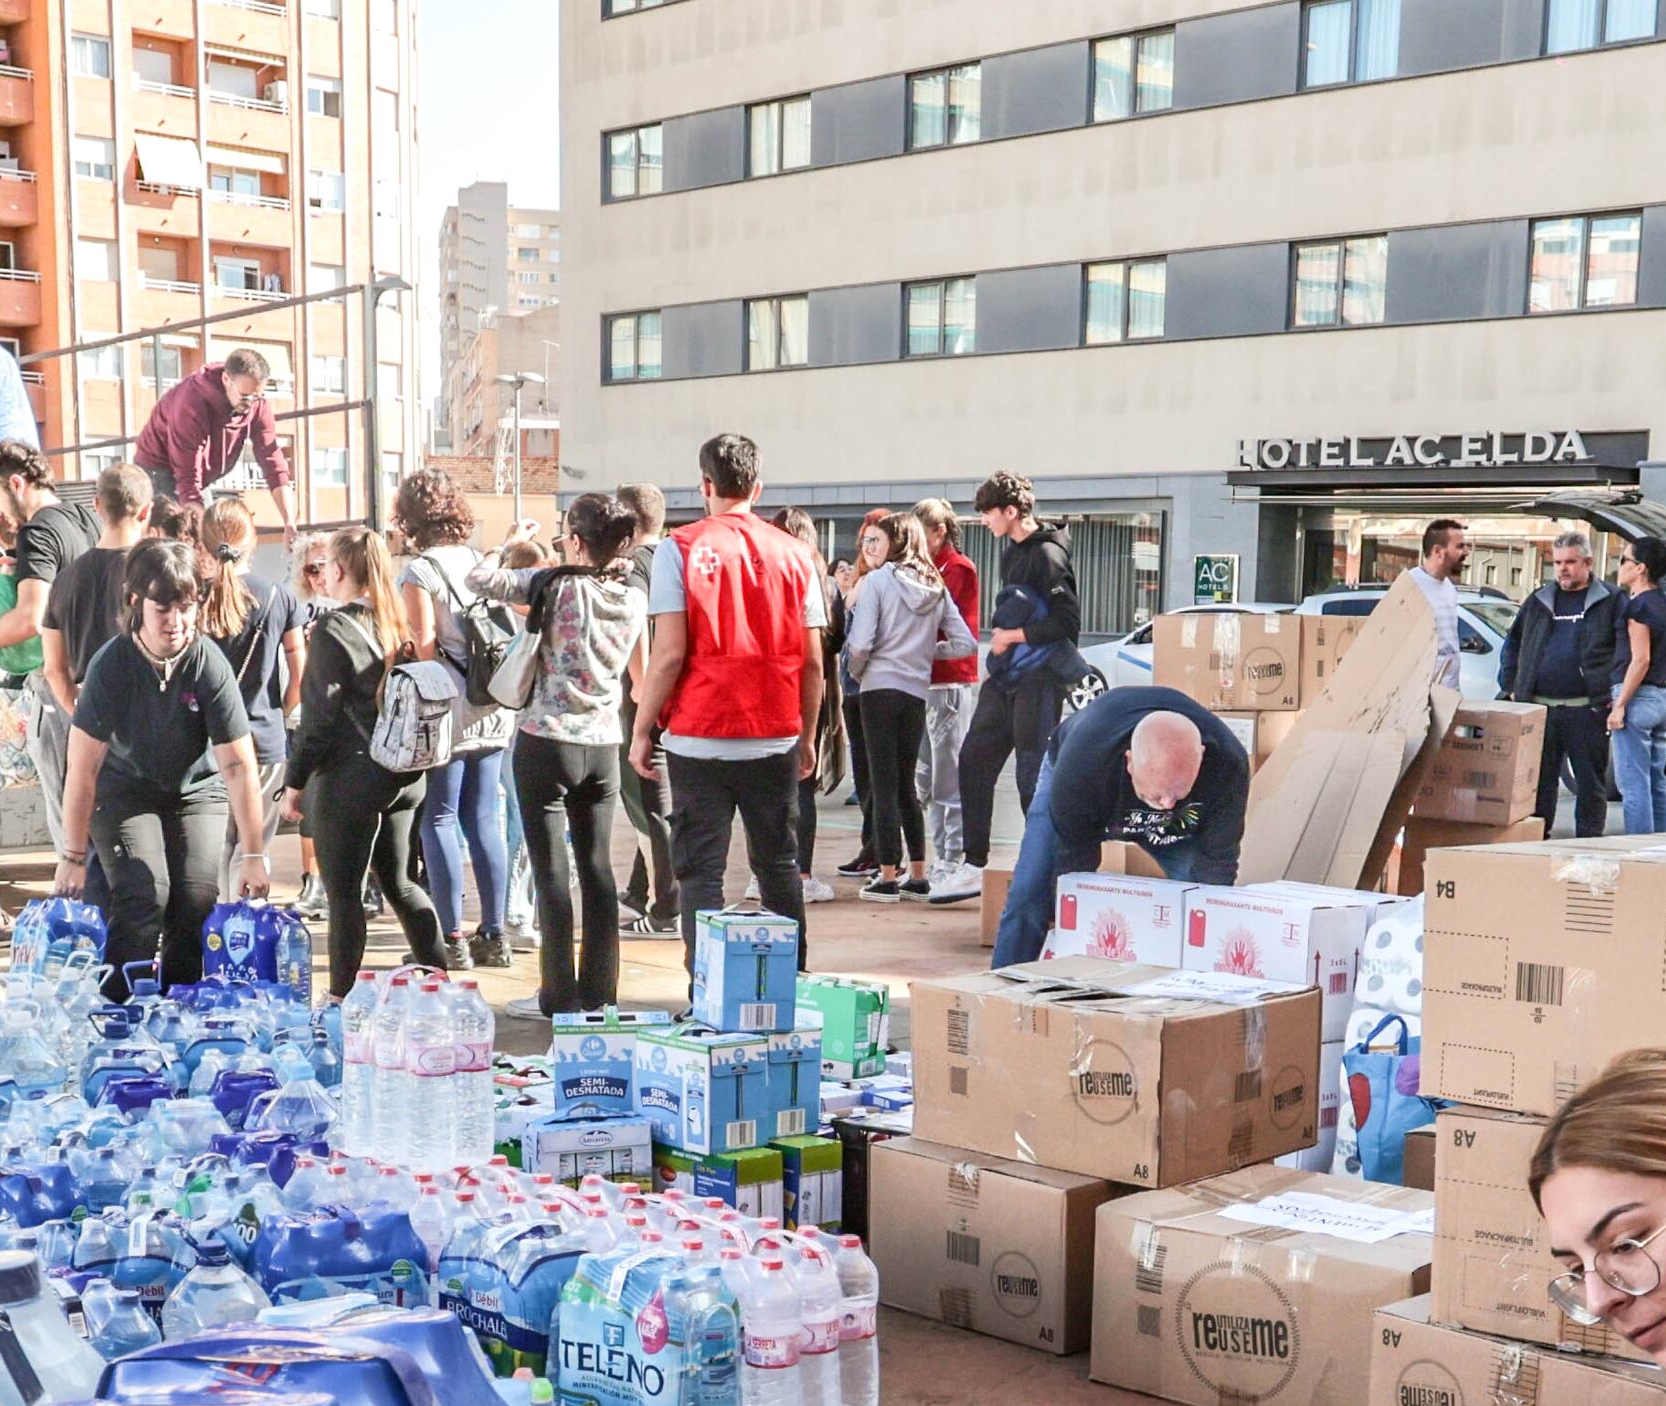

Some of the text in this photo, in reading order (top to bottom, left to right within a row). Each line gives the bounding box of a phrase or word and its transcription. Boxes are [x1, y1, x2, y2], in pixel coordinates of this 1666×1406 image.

[1236, 430, 1594, 470] HOTEL AC ELDA
[1198, 562, 1229, 580] AC
[1436, 879, 1456, 899] B4
[565, 1084, 625, 1099] DESNATADA
[580, 1077, 610, 1087] SEMI-
[641, 1096, 680, 1114] DESNATADA
[1453, 1128, 1476, 1149] A8
[1134, 1162, 1149, 1180] A8
[1215, 1313, 1252, 1333] UTILIZA
[1039, 1325, 1055, 1343] A8
[1381, 1327, 1403, 1349] A8
[561, 1339, 665, 1397] TELENO
